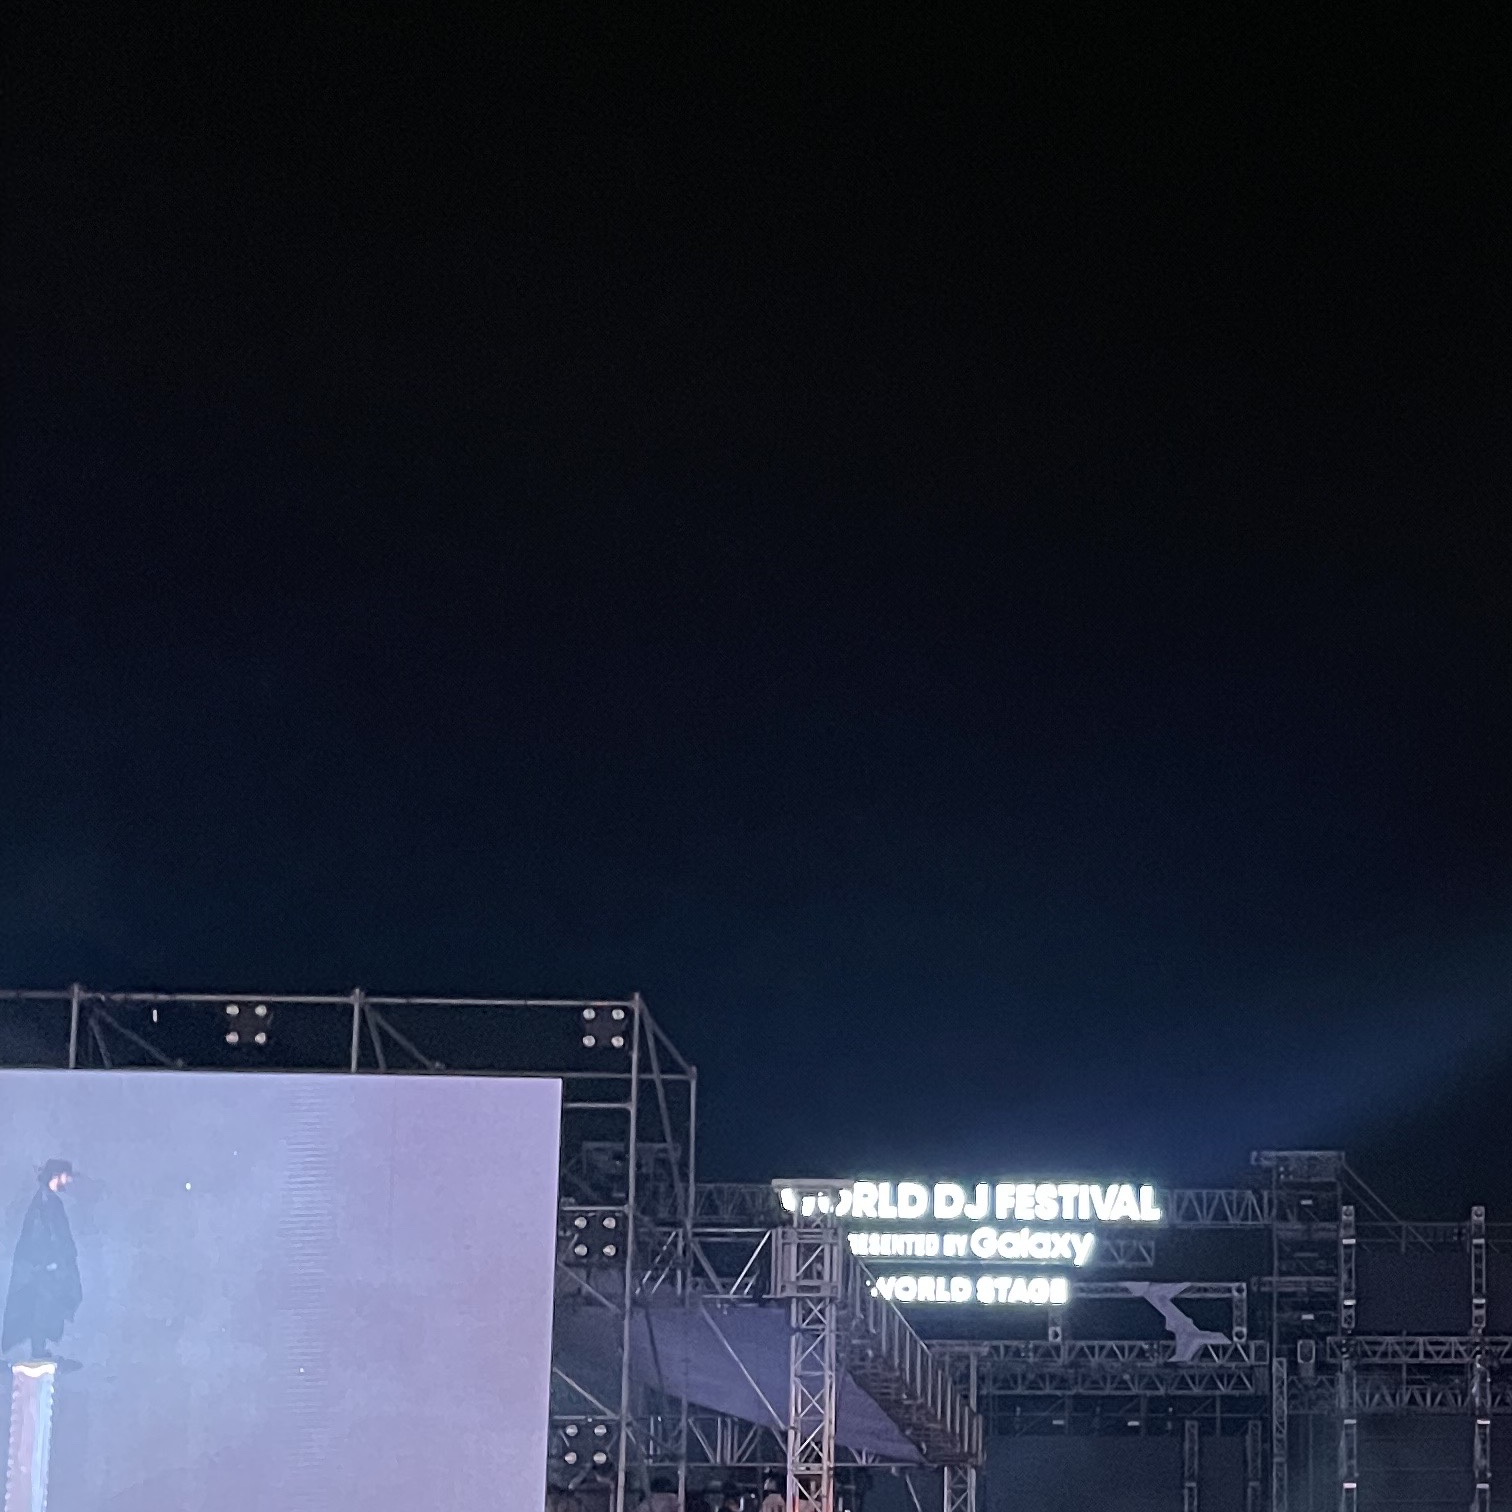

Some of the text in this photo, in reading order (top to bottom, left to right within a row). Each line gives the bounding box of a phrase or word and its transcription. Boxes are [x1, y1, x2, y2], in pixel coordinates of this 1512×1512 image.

[933, 1182, 988, 1220] DJ
[995, 1183, 1161, 1221] FESTIVAL
[970, 1226, 1095, 1267] Galaxy
[976, 1276, 1068, 1304] STAGE
